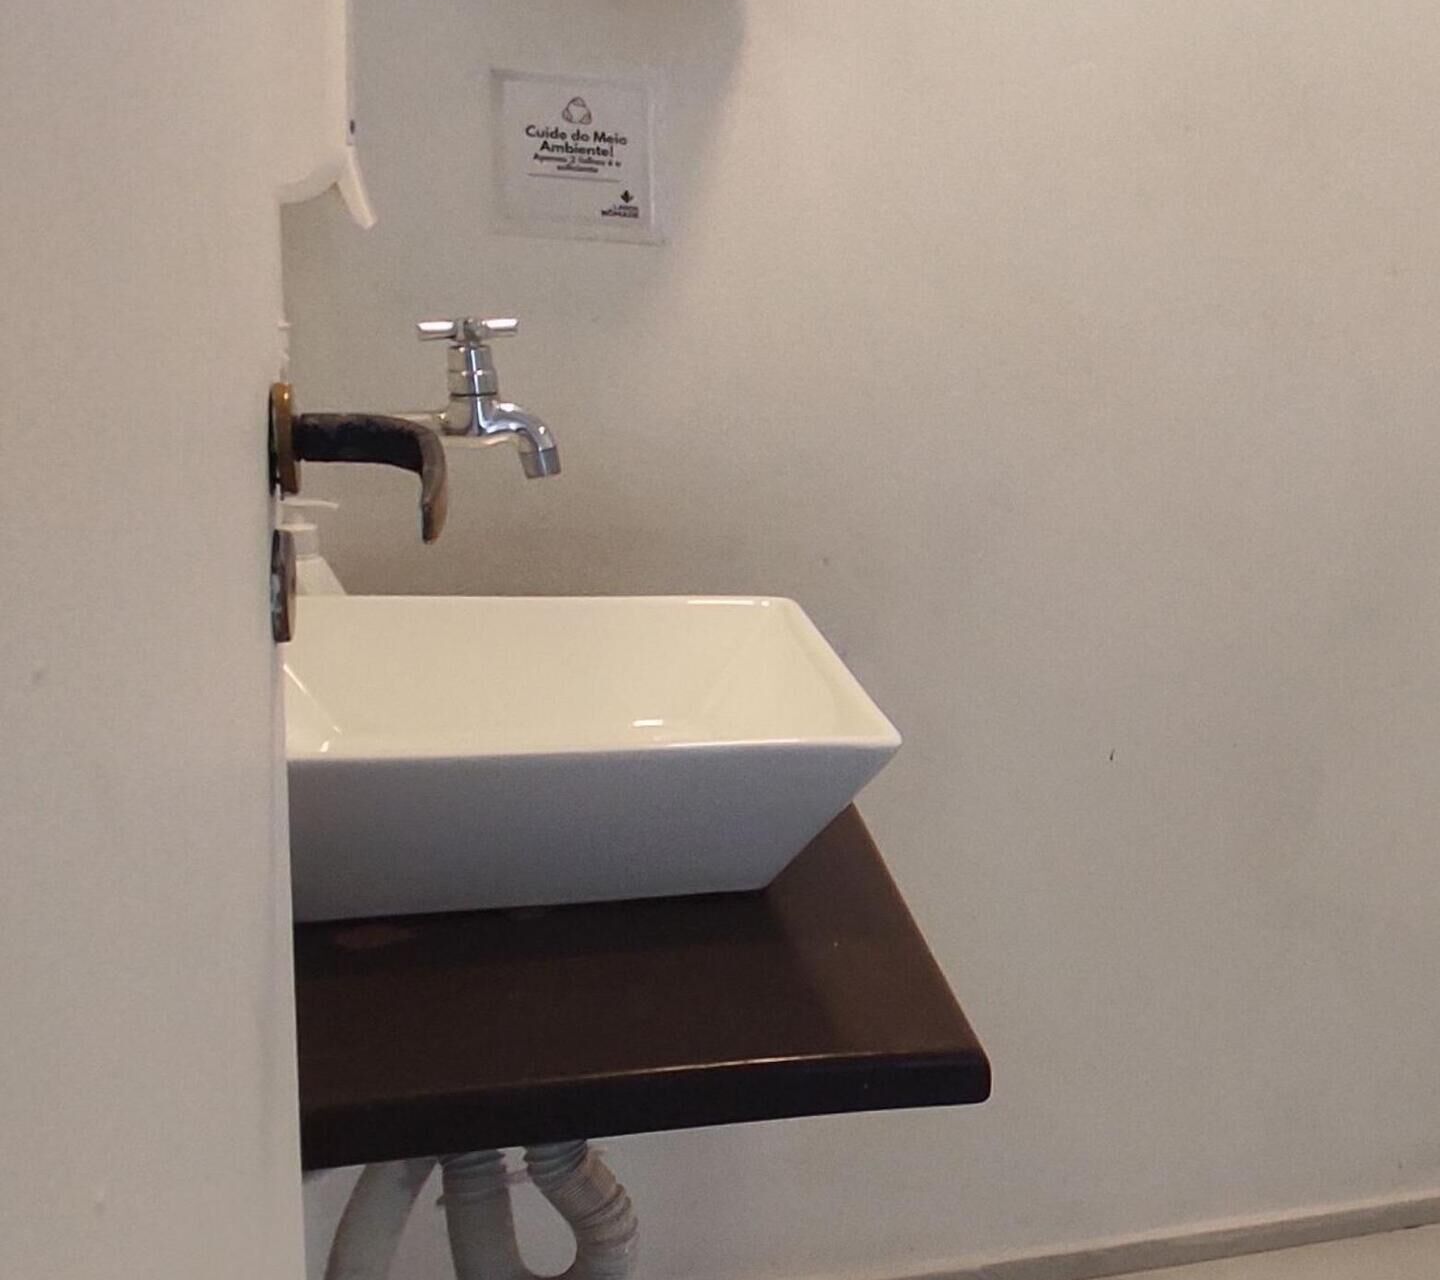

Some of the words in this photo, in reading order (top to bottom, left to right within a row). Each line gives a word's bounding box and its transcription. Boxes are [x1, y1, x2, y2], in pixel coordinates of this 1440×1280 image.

[525, 125, 567, 140] Cuide
[571, 129, 590, 142] do
[593, 131, 628, 146] Meio
[540, 140, 614, 158] Ambiente!
